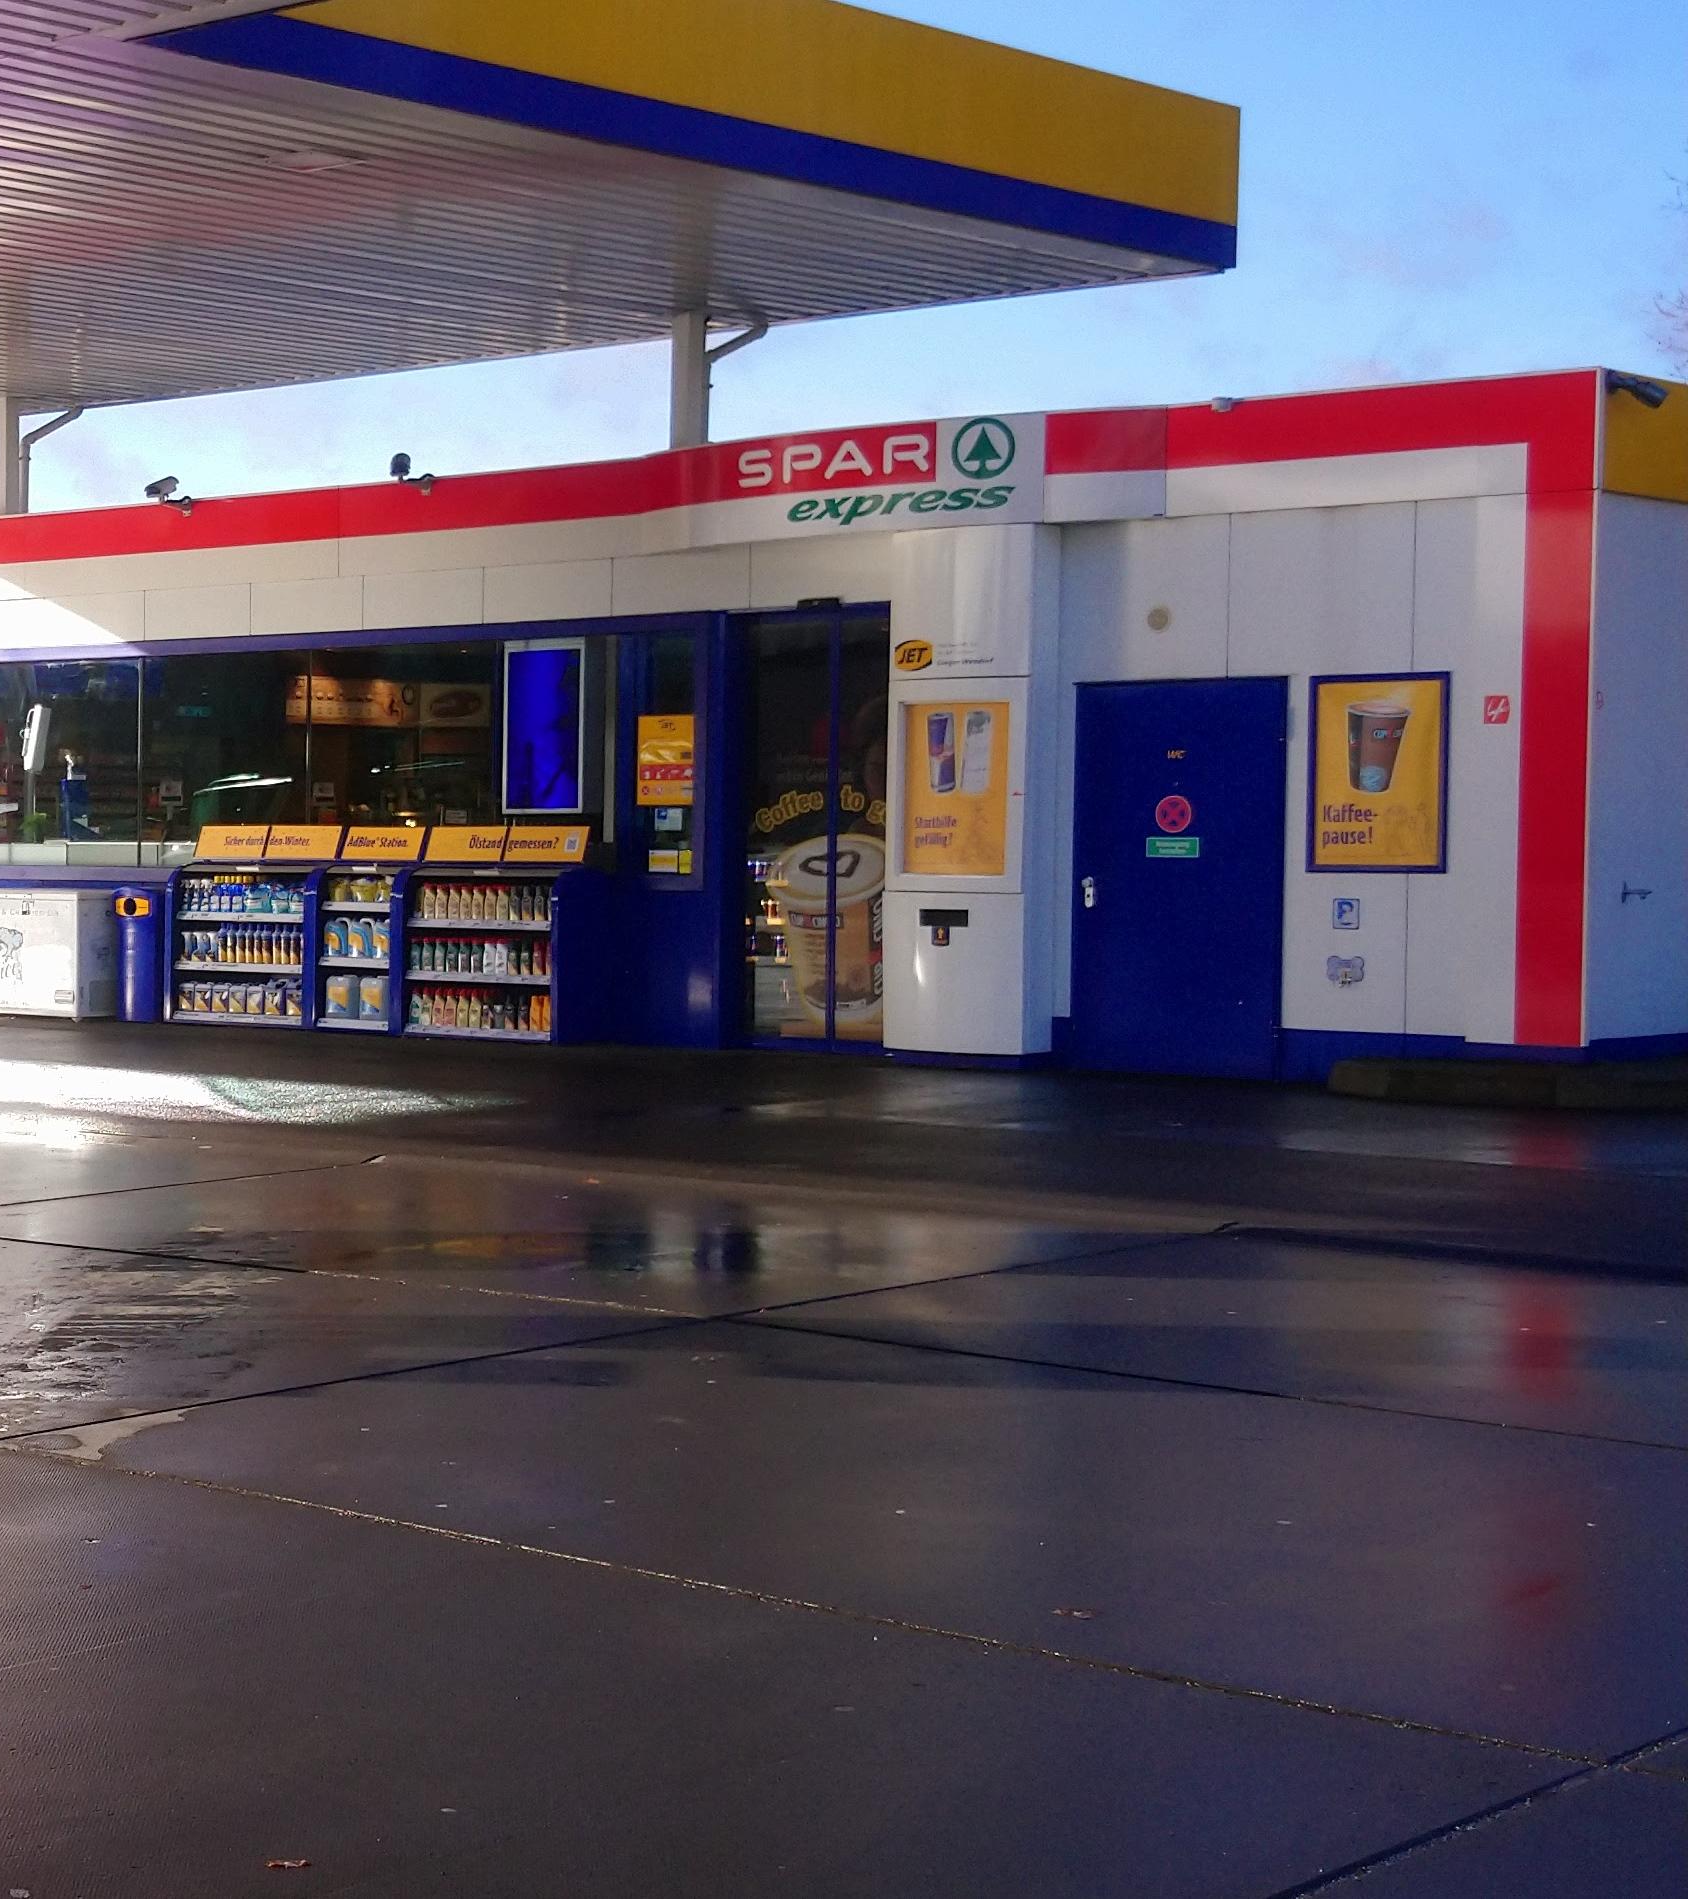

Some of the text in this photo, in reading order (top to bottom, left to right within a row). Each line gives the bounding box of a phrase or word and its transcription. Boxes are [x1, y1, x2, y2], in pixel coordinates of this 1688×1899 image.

[738, 434, 929, 488] SPAR
[787, 486, 1017, 526] express
[897, 647, 928, 665] JET
[756, 784, 886, 833] Coffee to g
[1323, 804, 1379, 823] Kaffee-
[915, 815, 957, 829] Starthilfe
[469, 834, 560, 852] Ölstand gemessen?
[1322, 826, 1373, 849] pause!
